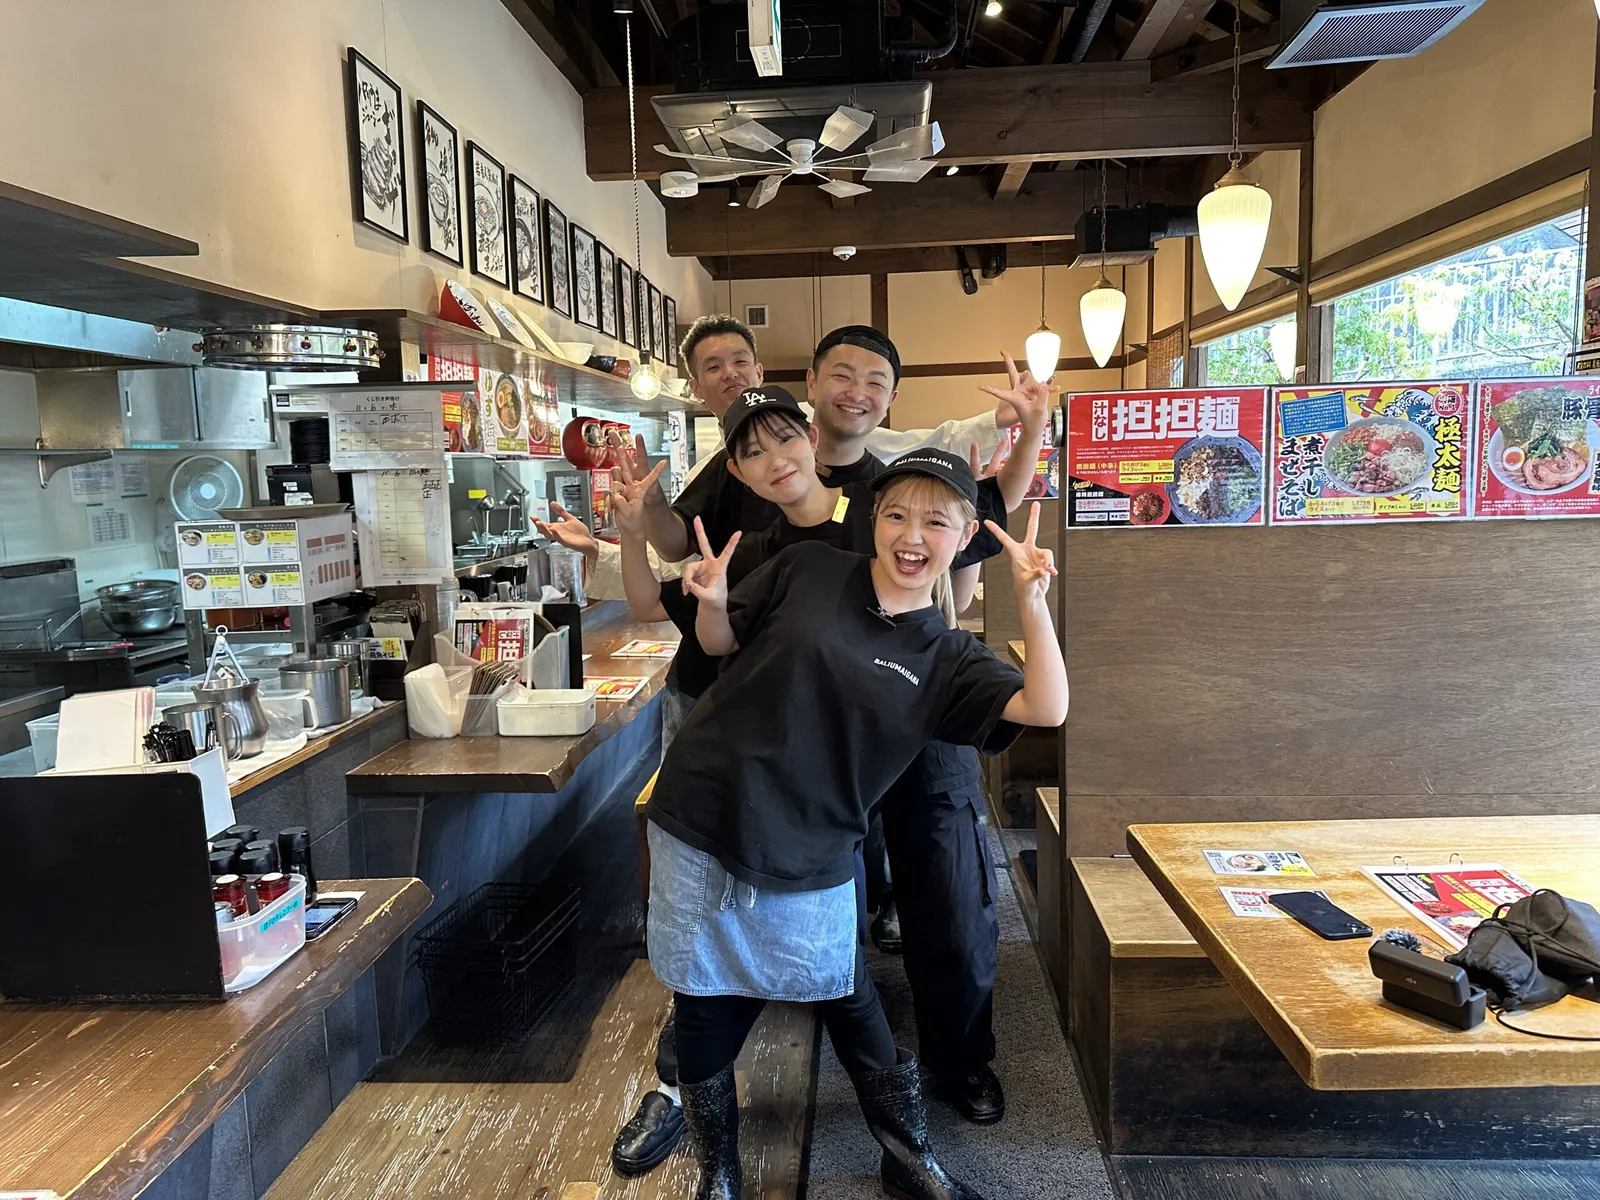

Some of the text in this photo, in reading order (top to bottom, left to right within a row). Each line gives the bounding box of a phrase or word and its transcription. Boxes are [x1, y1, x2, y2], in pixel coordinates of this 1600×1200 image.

[1094, 402, 1106, 440] 汁なし
[1112, 396, 1240, 441] 担担麺
[1279, 437, 1300, 516] まぜそば
[1301, 436, 1323, 496] 煮干し
[1432, 416, 1462, 493] 極太麺
